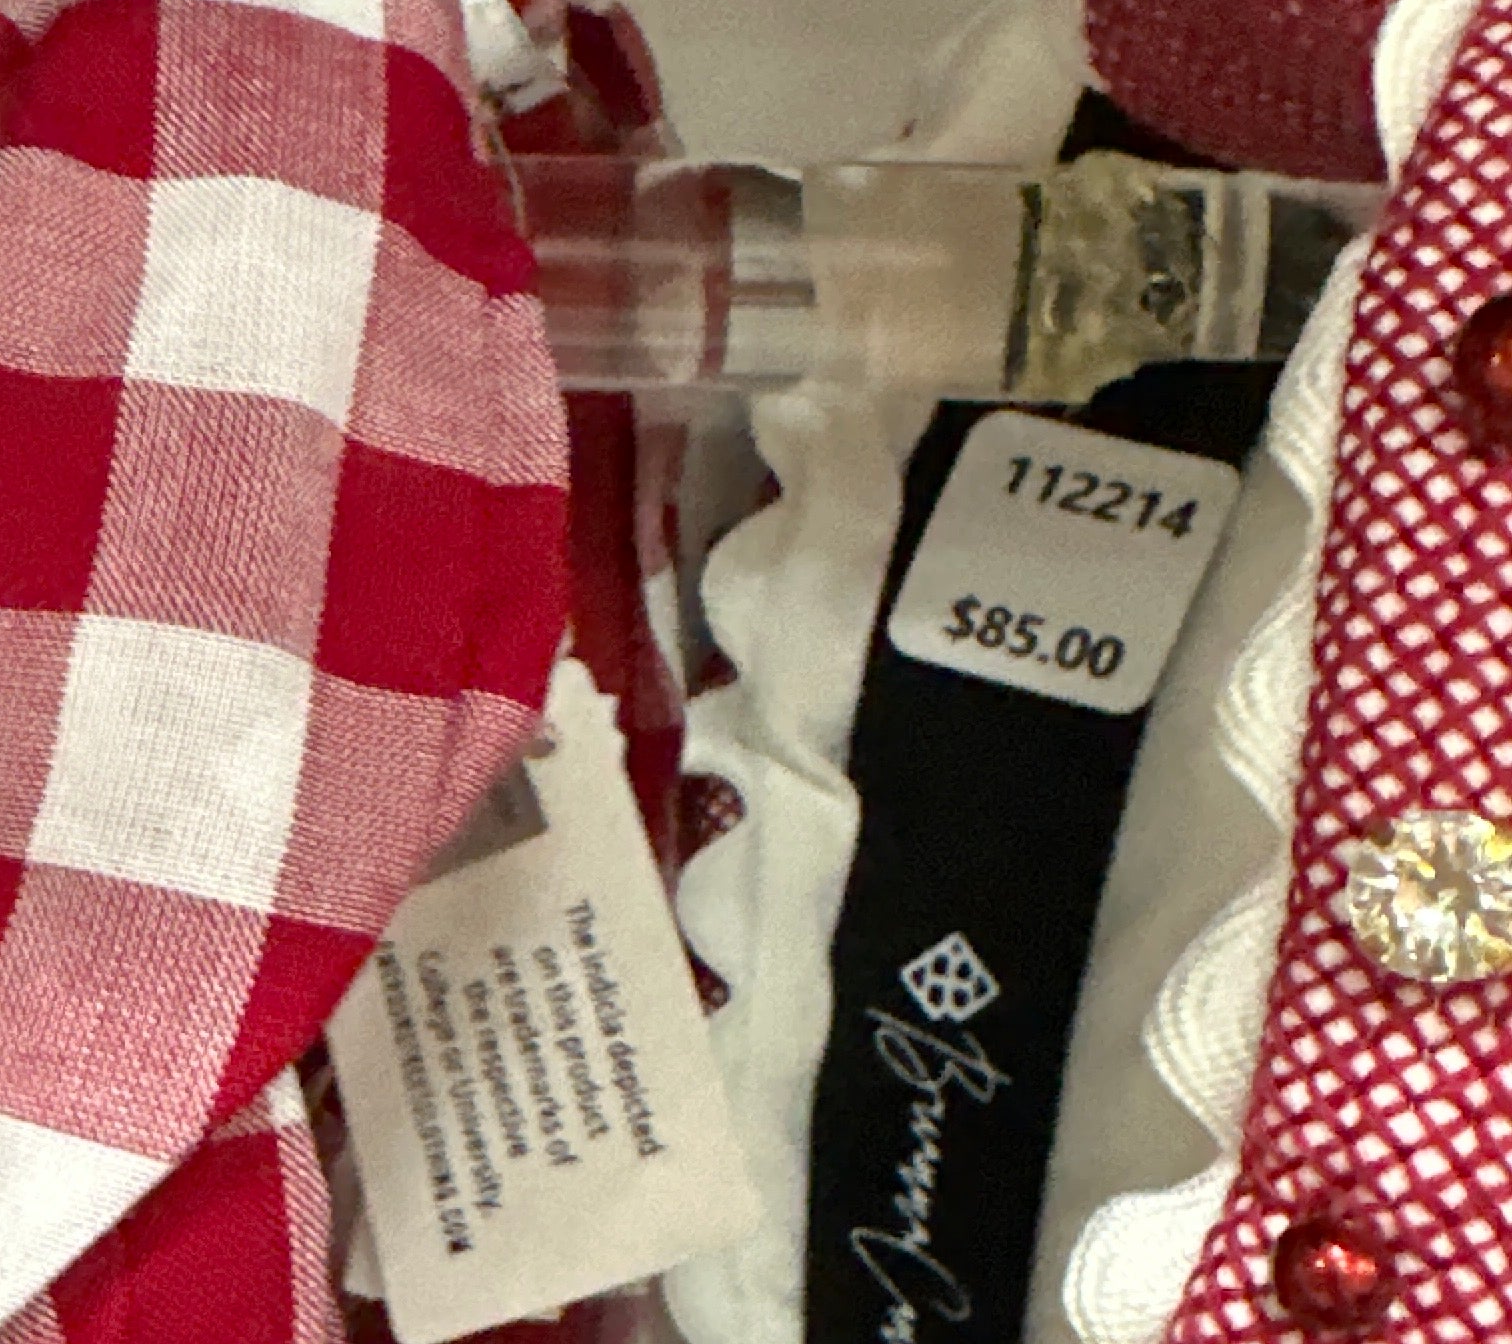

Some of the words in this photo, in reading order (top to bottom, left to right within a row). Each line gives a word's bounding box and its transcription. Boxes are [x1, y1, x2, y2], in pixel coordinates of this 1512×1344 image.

[1003, 457, 1200, 539] 112214
[943, 593, 1126, 679] $85.00
[491, 946, 521, 986] are
[532, 946, 561, 980] on
[544, 982, 578, 1032] this
[566, 899, 595, 949] The
[607, 1040, 666, 1158] depicted
[463, 981, 490, 1022] the
[478, 1027, 533, 1158] respective
[504, 987, 565, 1135] trademarks
[556, 1036, 611, 1140] product
[545, 1137, 582, 1166] of
